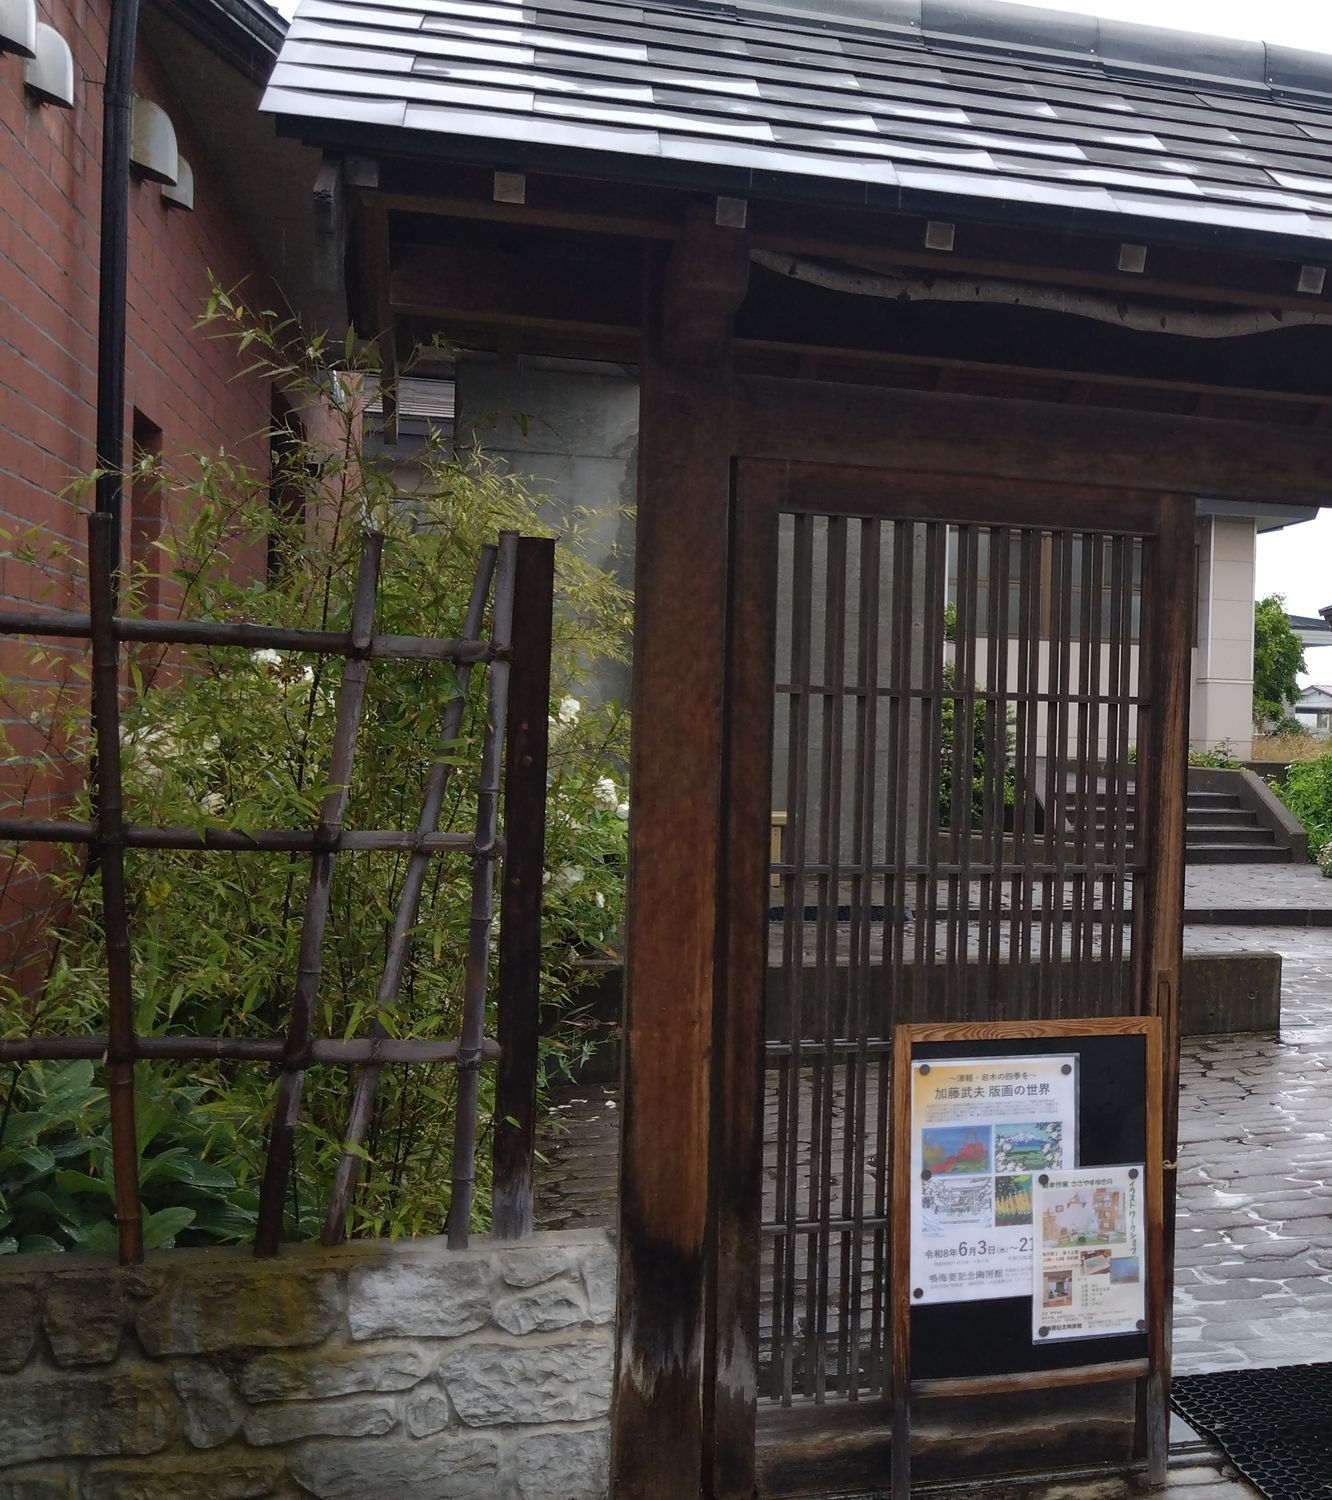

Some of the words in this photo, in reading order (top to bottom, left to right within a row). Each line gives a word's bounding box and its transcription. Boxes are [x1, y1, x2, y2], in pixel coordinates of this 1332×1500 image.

[935, 1086, 986, 1100] 加藤武夫
[989, 1083, 1050, 1097] 版画の世界
[928, 1269, 1003, 1283] 鳴海要記念陶房館
